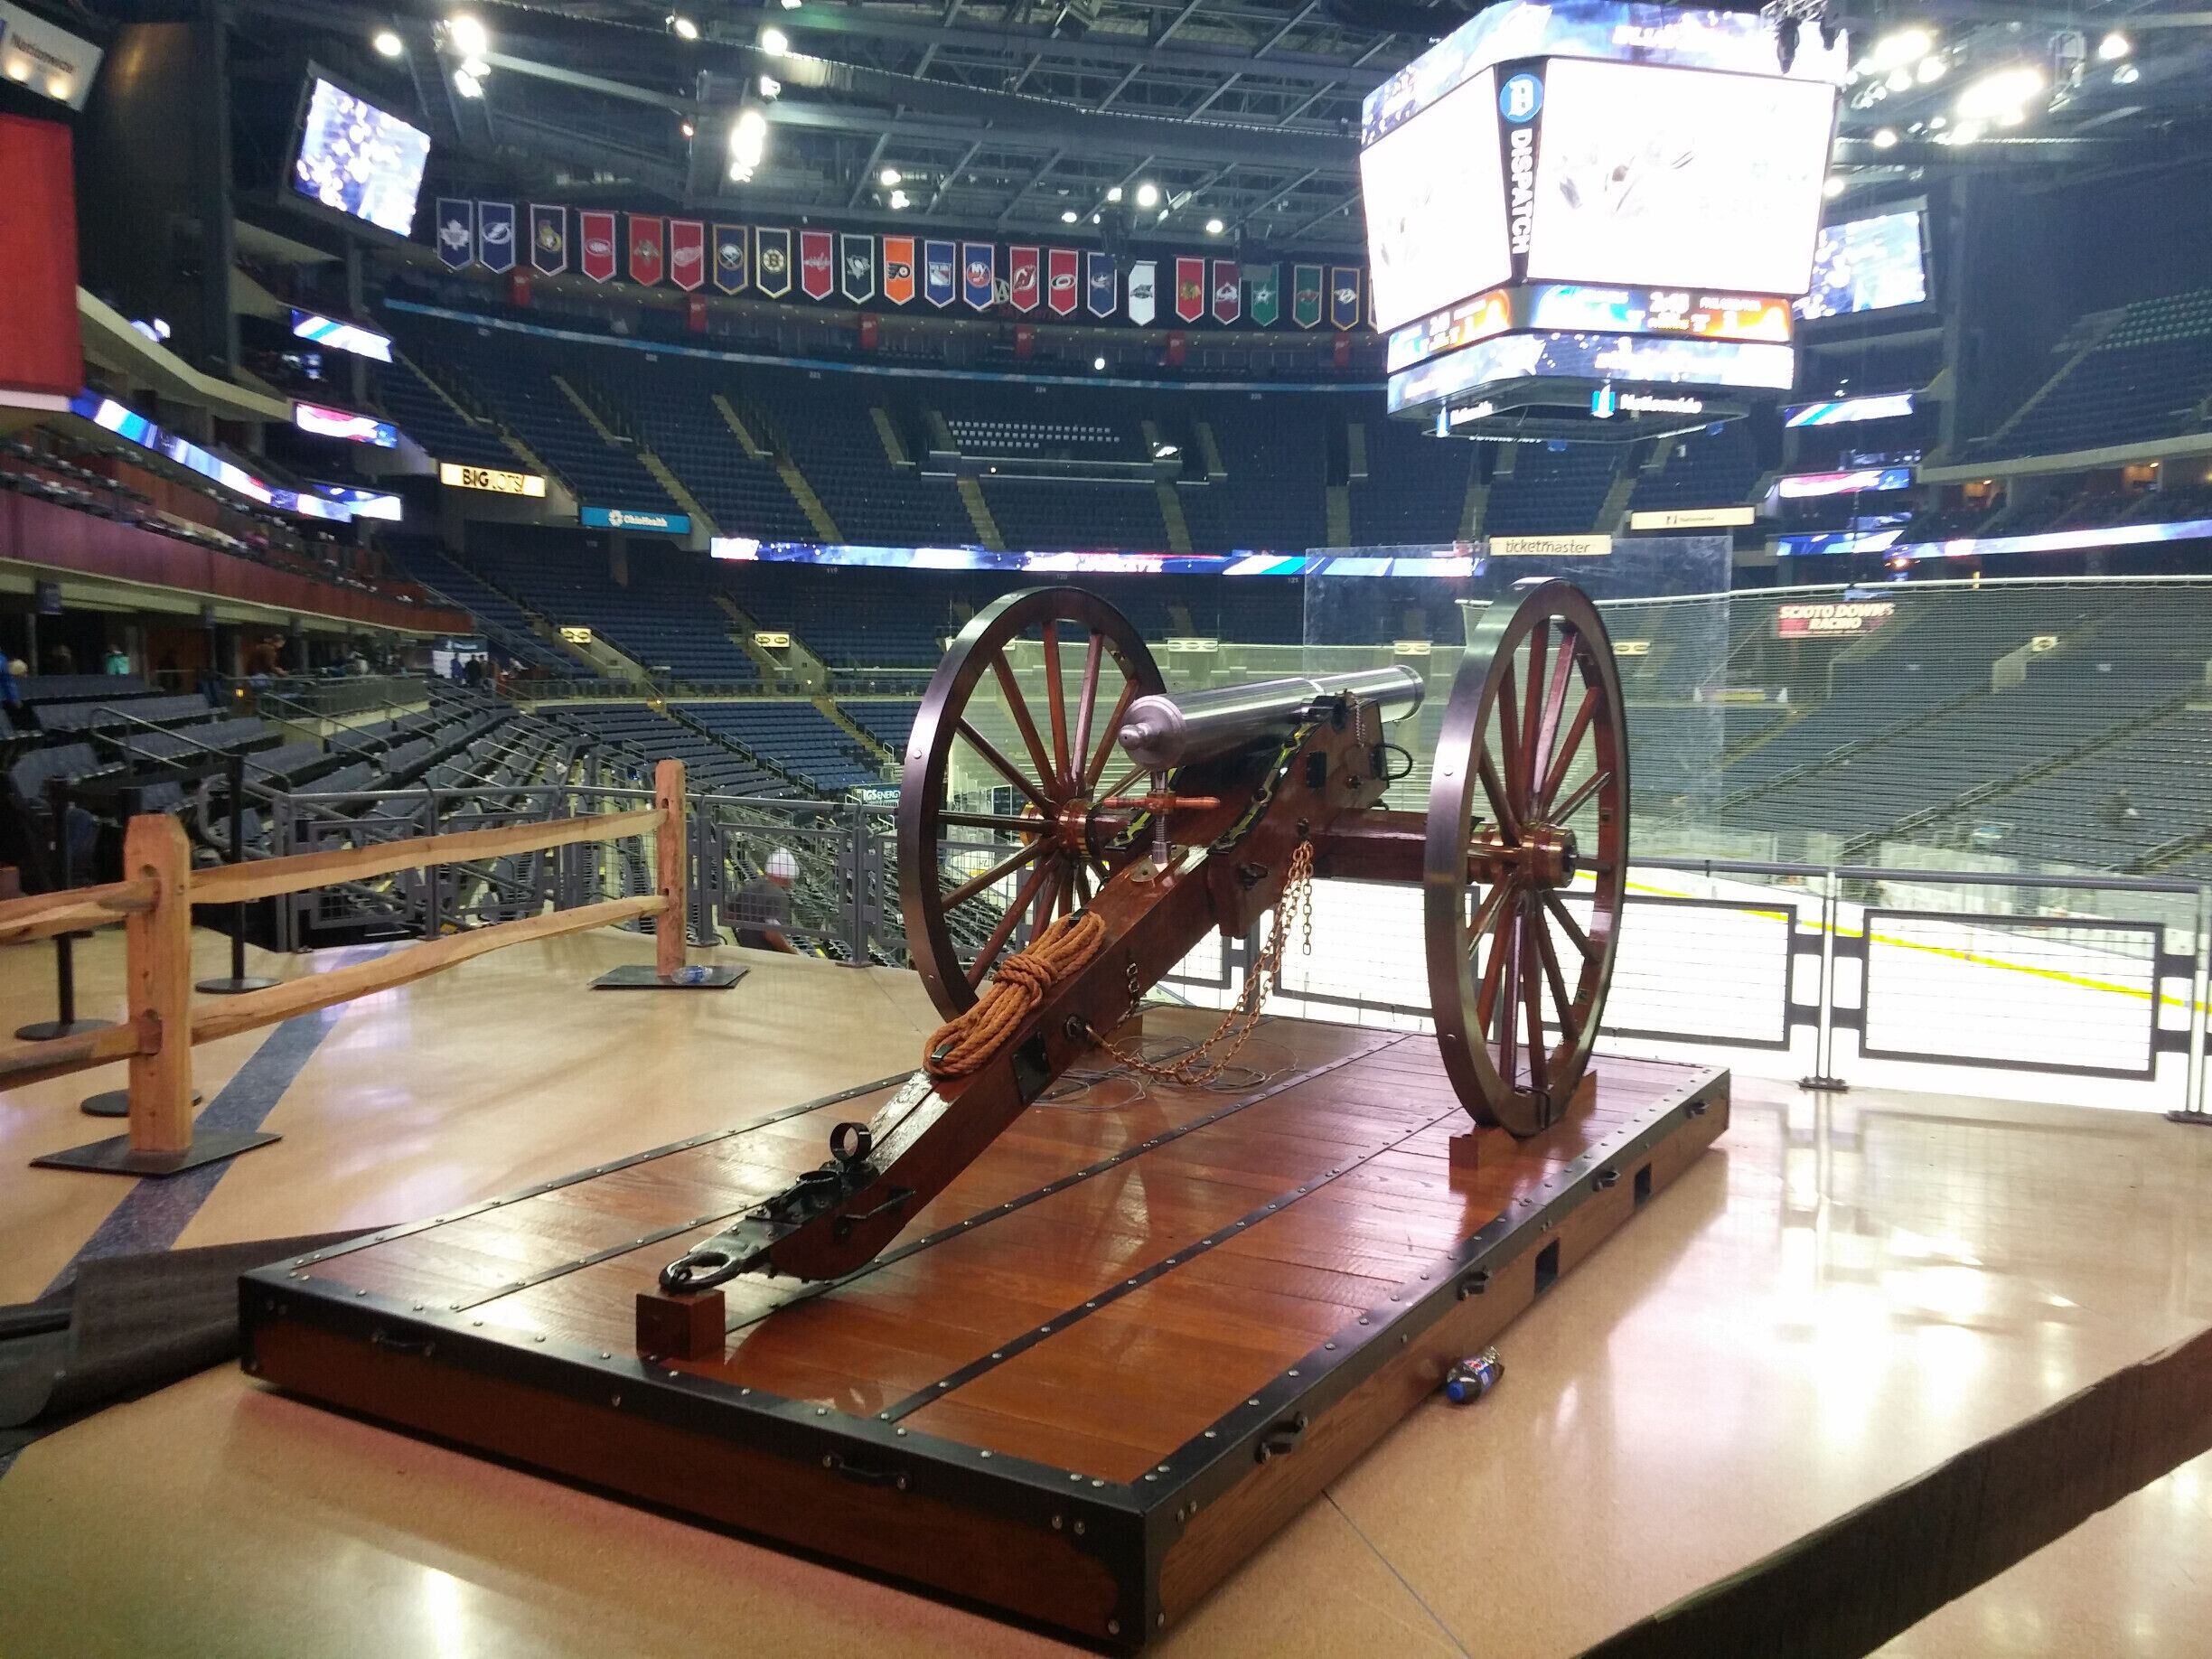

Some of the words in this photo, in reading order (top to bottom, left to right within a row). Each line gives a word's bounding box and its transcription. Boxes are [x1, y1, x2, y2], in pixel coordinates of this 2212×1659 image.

[1510, 127, 1533, 254] DISPATCH
[1620, 394, 1703, 414] Nationwide
[463, 468, 489, 487] BIG
[1505, 539, 1591, 554] ticketmaster
[1779, 605, 1834, 619] SCIOTO
[1835, 603, 1896, 618] DOWNS
[1809, 617, 1862, 631] RACINO
